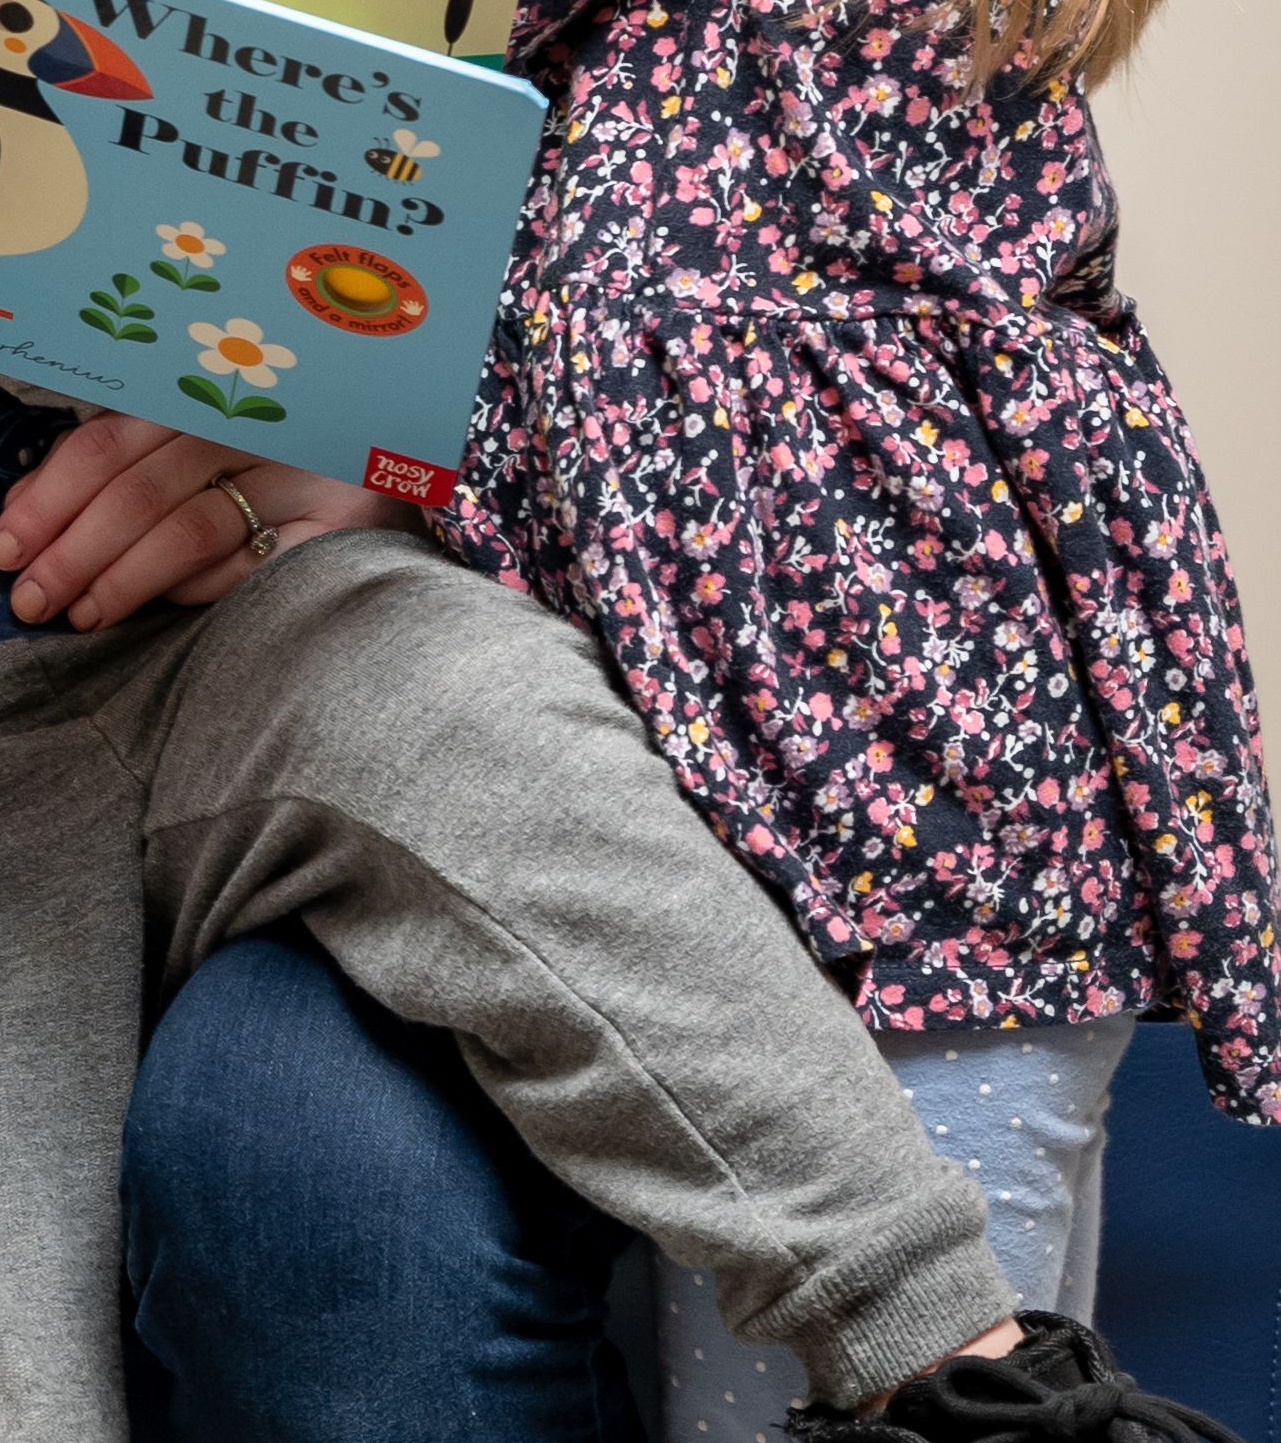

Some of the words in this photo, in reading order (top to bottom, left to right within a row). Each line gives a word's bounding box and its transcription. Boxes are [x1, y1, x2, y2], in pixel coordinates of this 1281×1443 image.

[203, 89, 319, 148] the
[109, 104, 445, 236] Puffin?
[309, 248, 350, 266] Felt
[358, 252, 411, 288] flaps
[298, 287, 331, 312] and
[329, 313, 342, 322] a
[349, 314, 413, 333] mirror!
[376, 455, 435, 485] nosy
